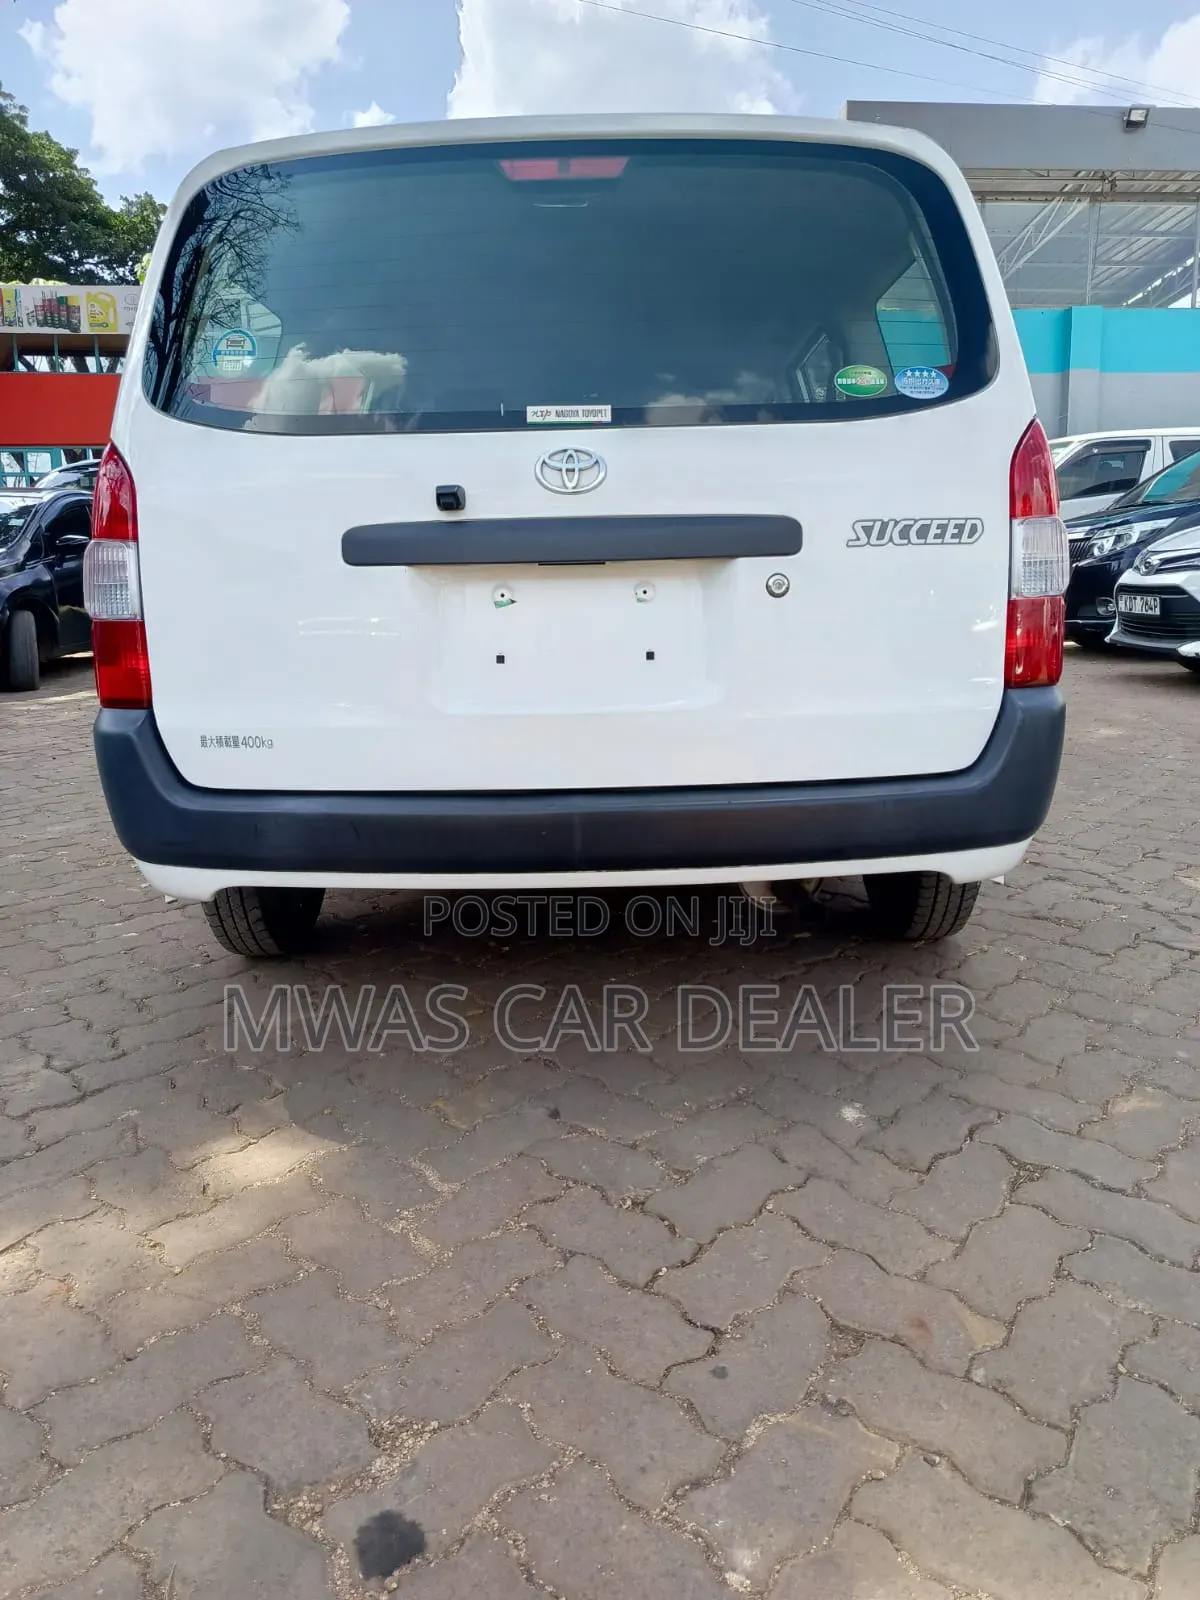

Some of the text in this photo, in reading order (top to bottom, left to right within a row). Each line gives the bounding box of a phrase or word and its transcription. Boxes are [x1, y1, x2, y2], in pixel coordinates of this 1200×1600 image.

[555, 408, 580, 418] NAGOYA
[582, 408, 607, 418] TOYOPET
[846, 517, 985, 547] SUCCEED
